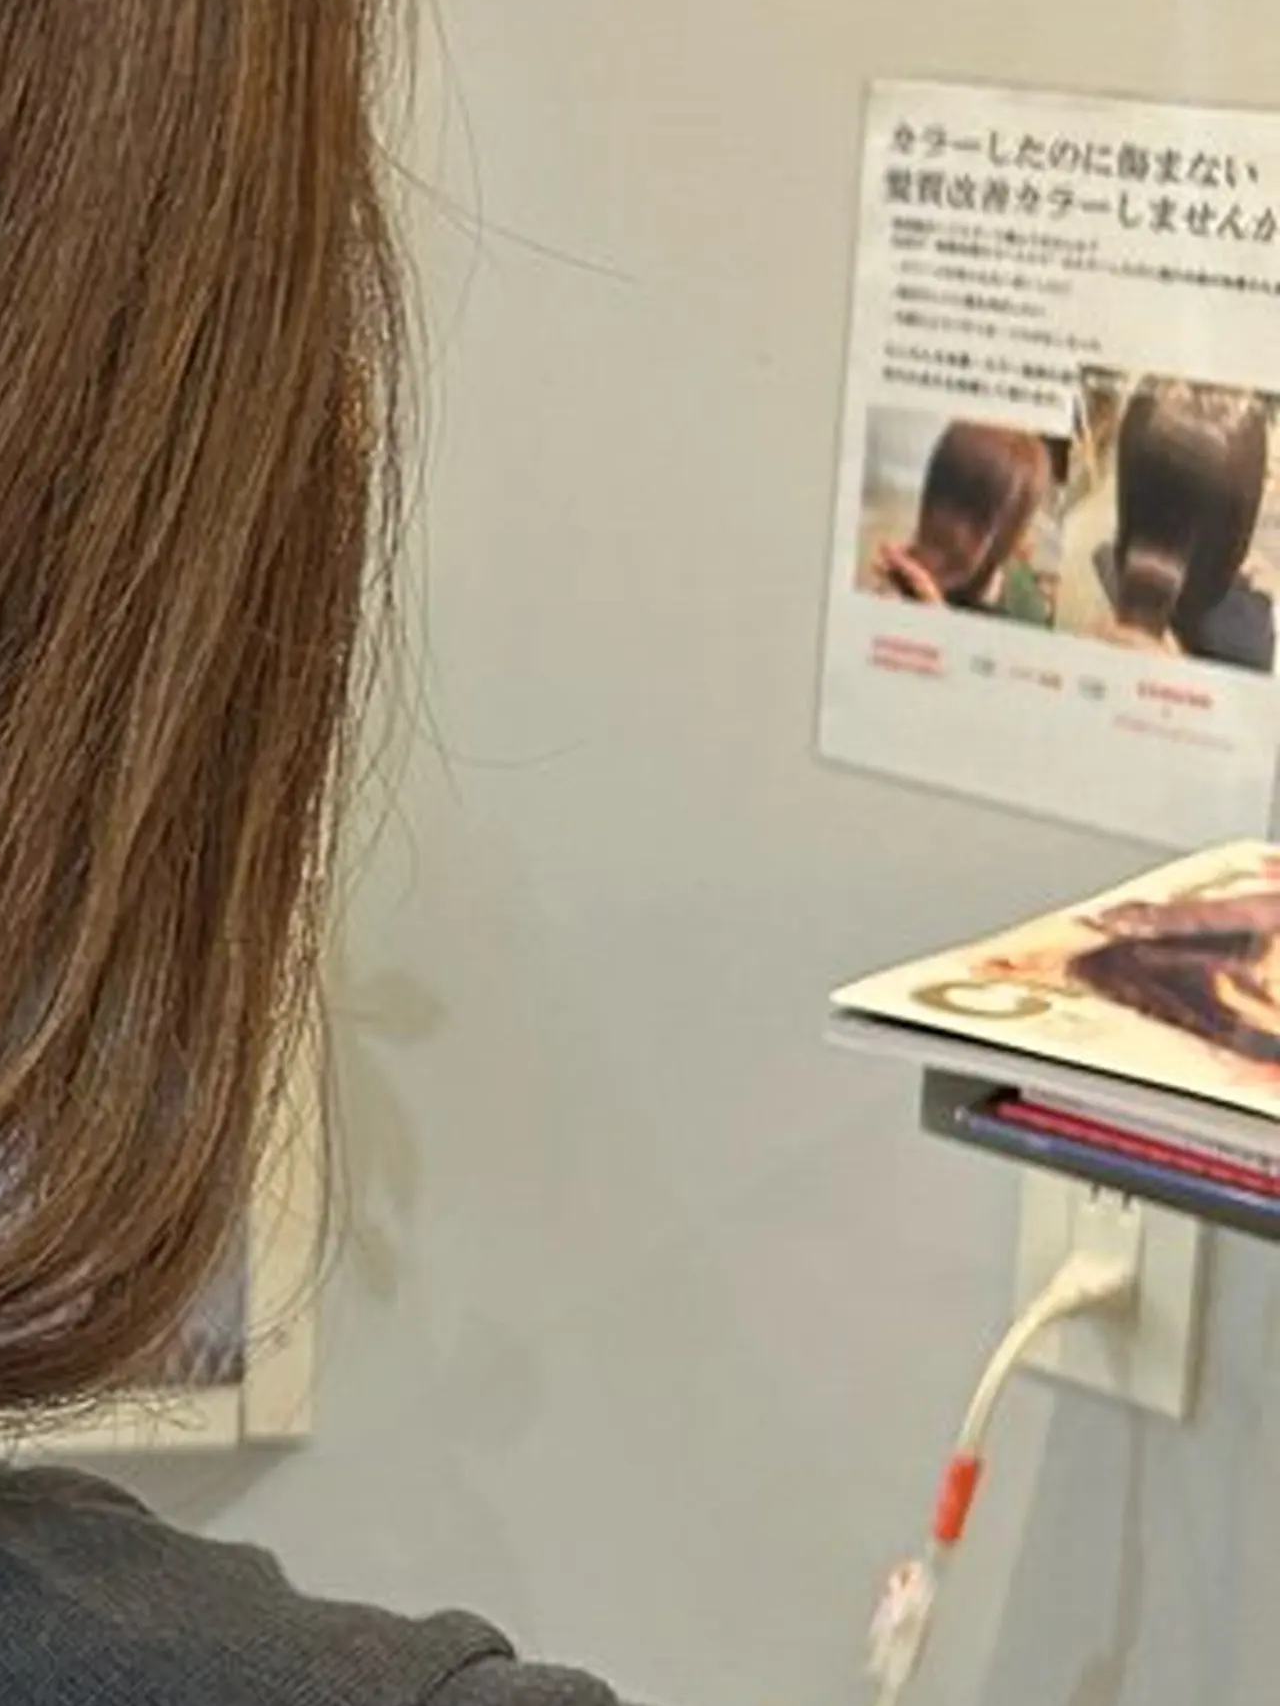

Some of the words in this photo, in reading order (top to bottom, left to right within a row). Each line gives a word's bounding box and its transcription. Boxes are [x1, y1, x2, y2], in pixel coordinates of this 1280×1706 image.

[889, 120, 1260, 190] カラーしたのに傷まない
